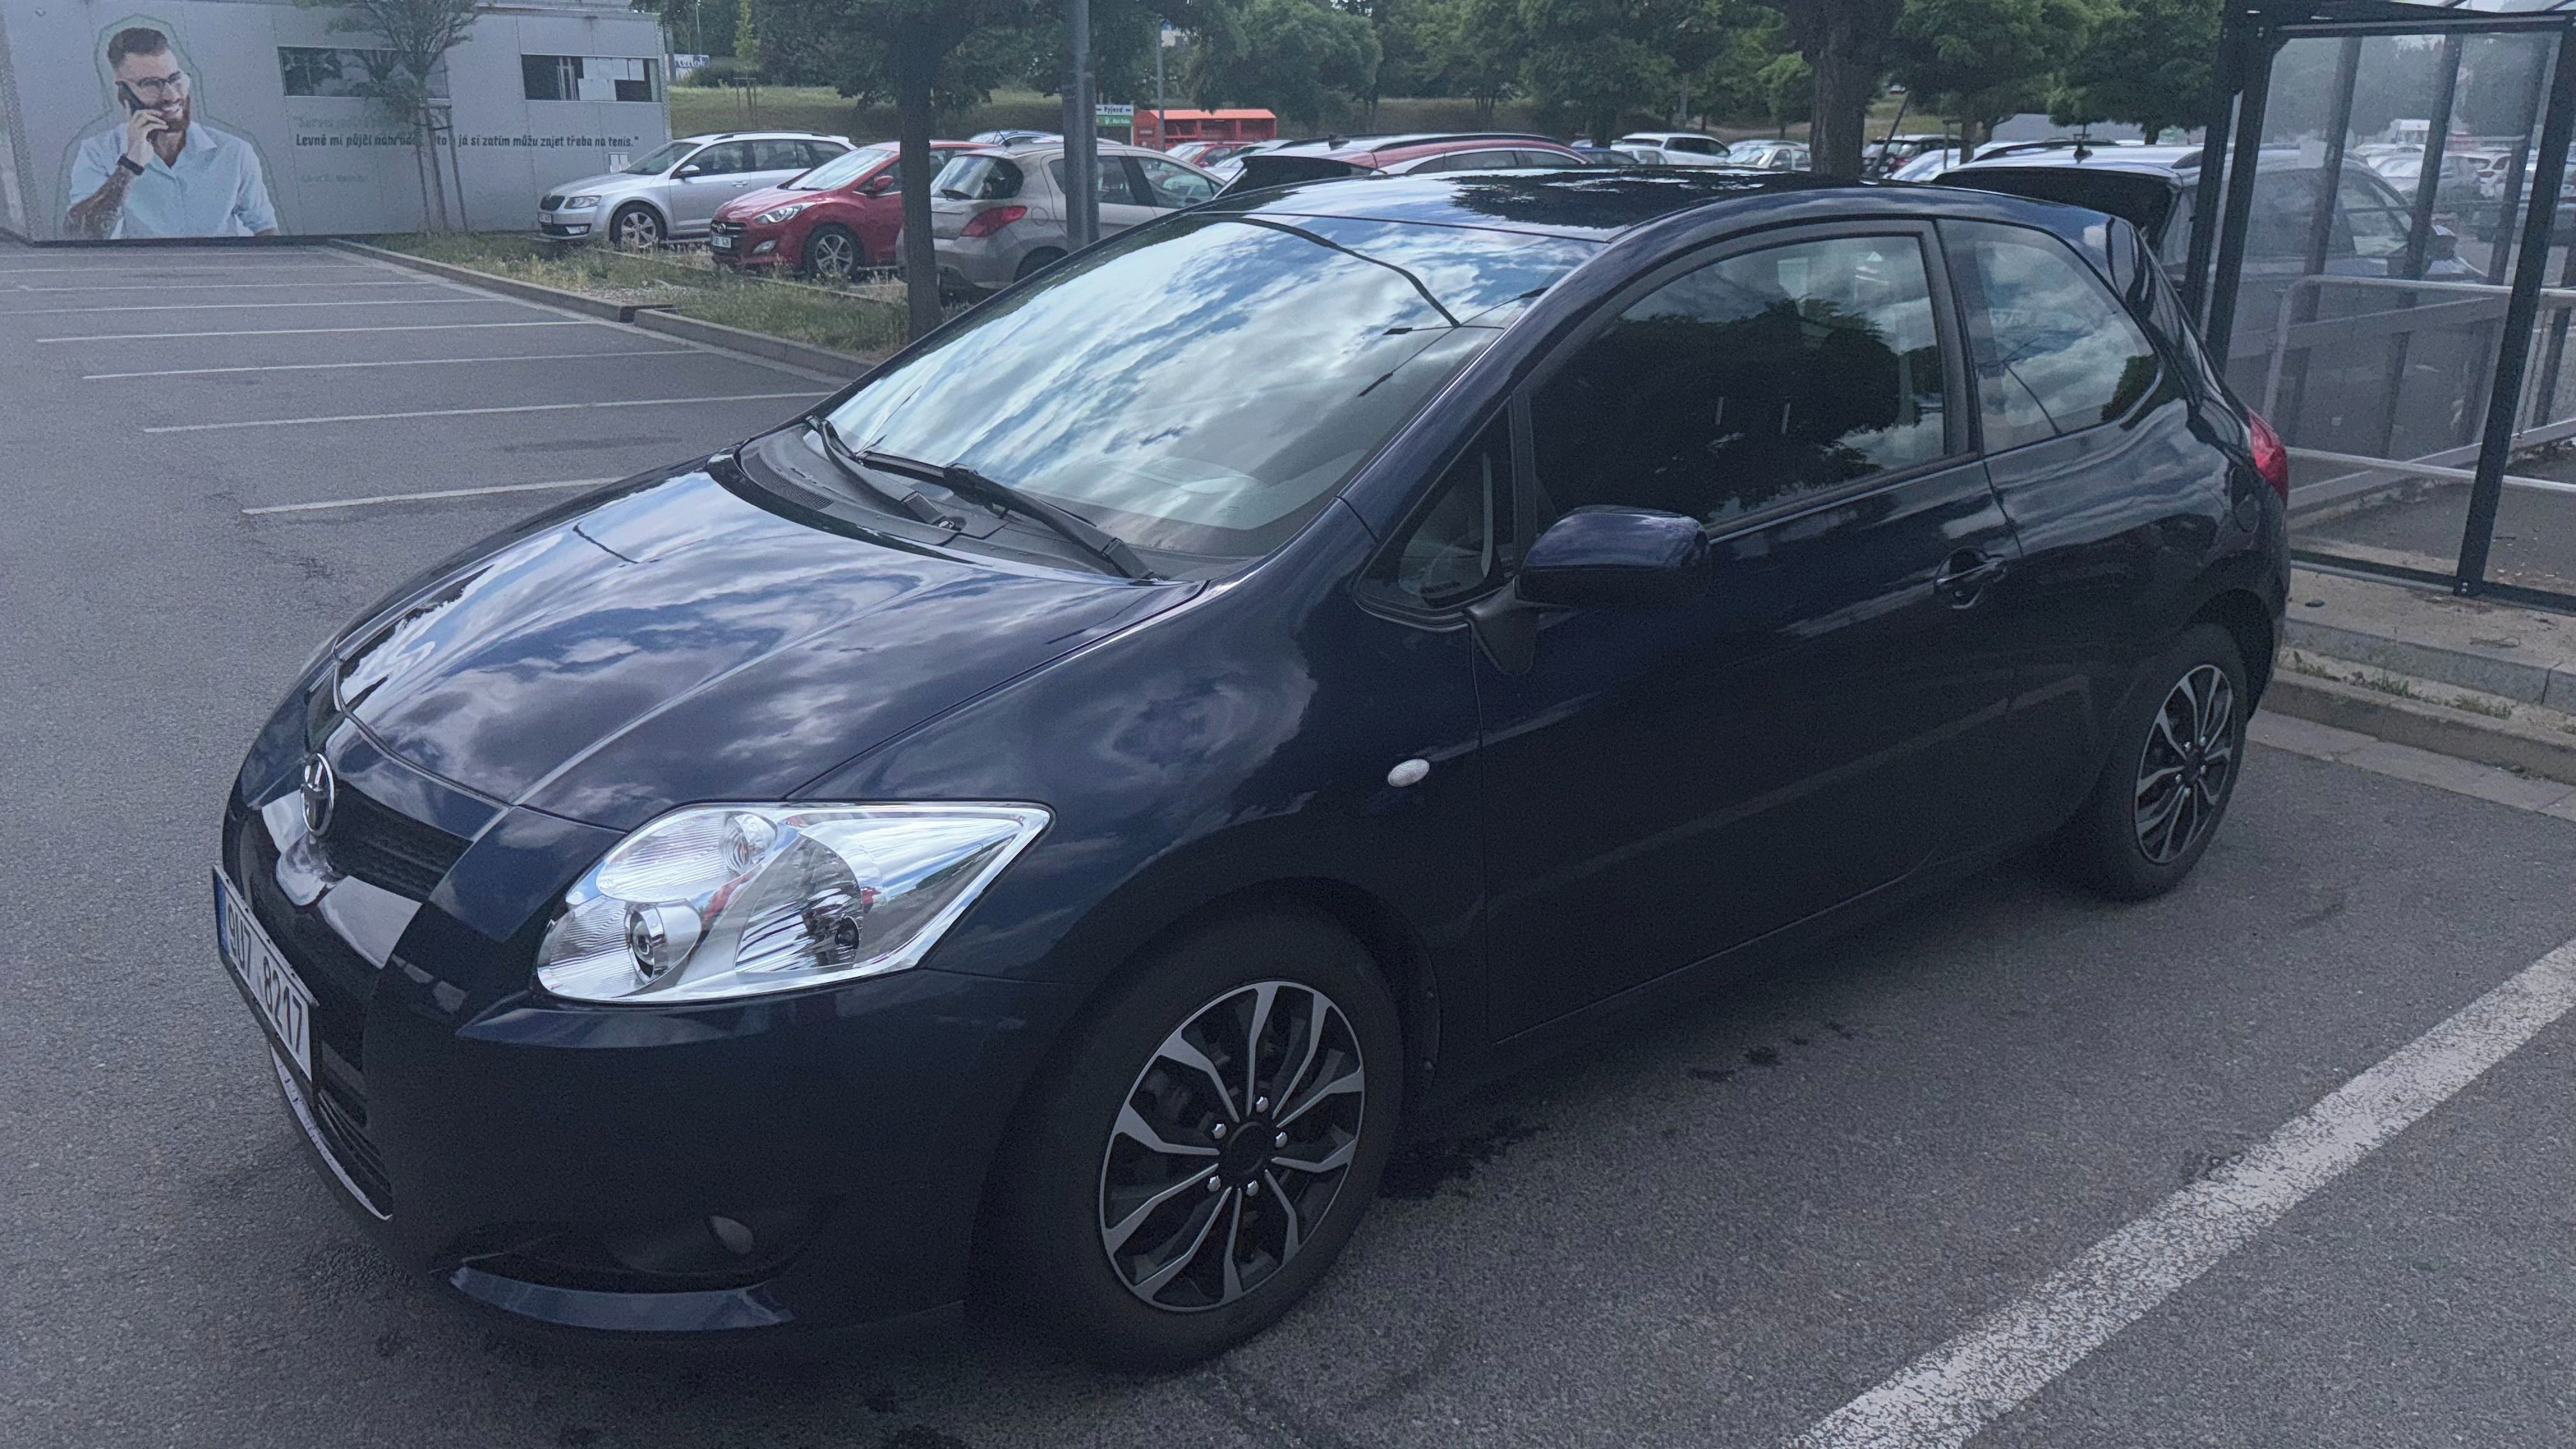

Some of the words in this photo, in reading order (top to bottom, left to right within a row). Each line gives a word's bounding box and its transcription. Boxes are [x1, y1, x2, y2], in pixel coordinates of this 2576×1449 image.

[482, 135, 510, 147] zatím
[513, 134, 538, 147] můžu
[540, 135, 564, 148] zajet
[567, 135, 592, 147] třeba
[595, 139, 606, 147] na
[228, 903, 251, 981] 9U7
[263, 955, 302, 1055] 8217
